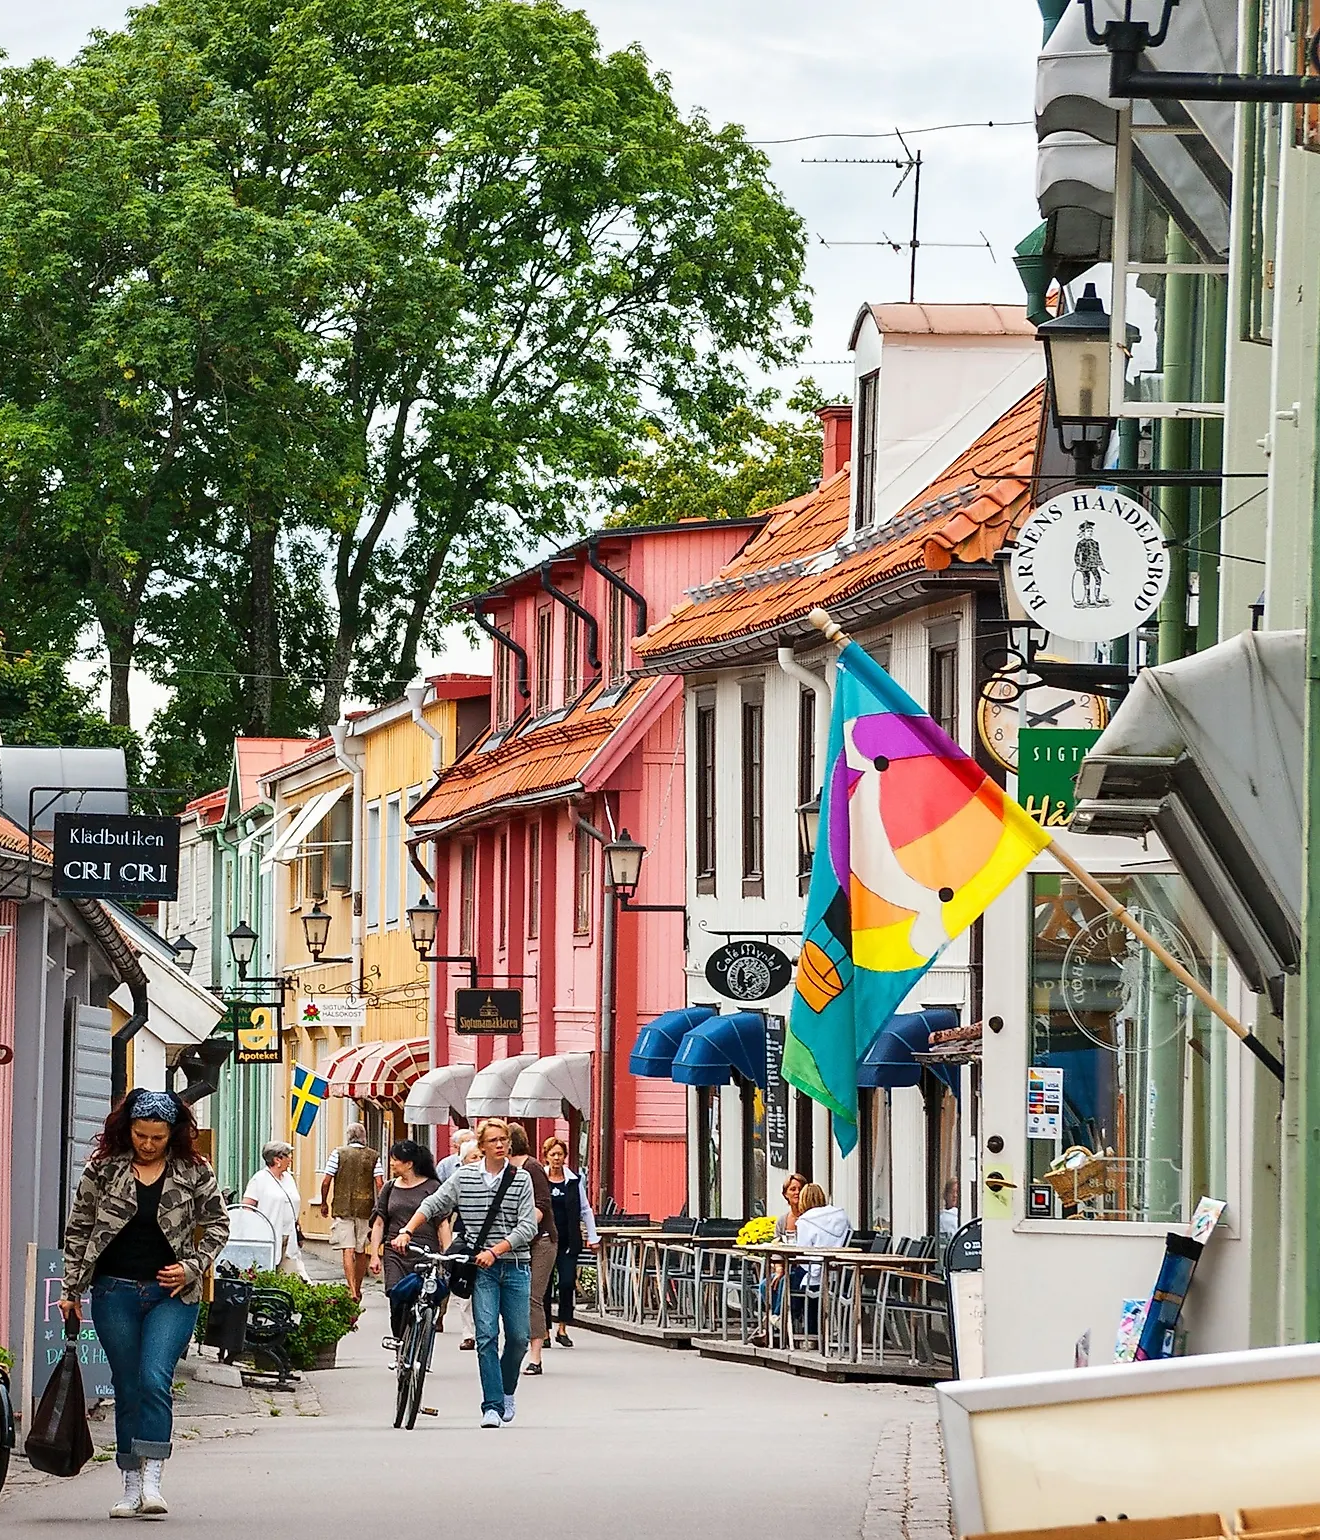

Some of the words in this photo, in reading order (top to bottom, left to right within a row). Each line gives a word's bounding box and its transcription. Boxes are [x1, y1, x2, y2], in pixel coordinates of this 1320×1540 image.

[1017, 503, 1063, 611] BARNENS
[1072, 494, 1164, 613] HANDELSBOD
[69, 827, 164, 847] Klädbutiken
[63, 861, 111, 881] CRI
[119, 862, 168, 883] CRI
[716, 948, 740, 972] Café
[238, 1051, 278, 1062] Apoteket
